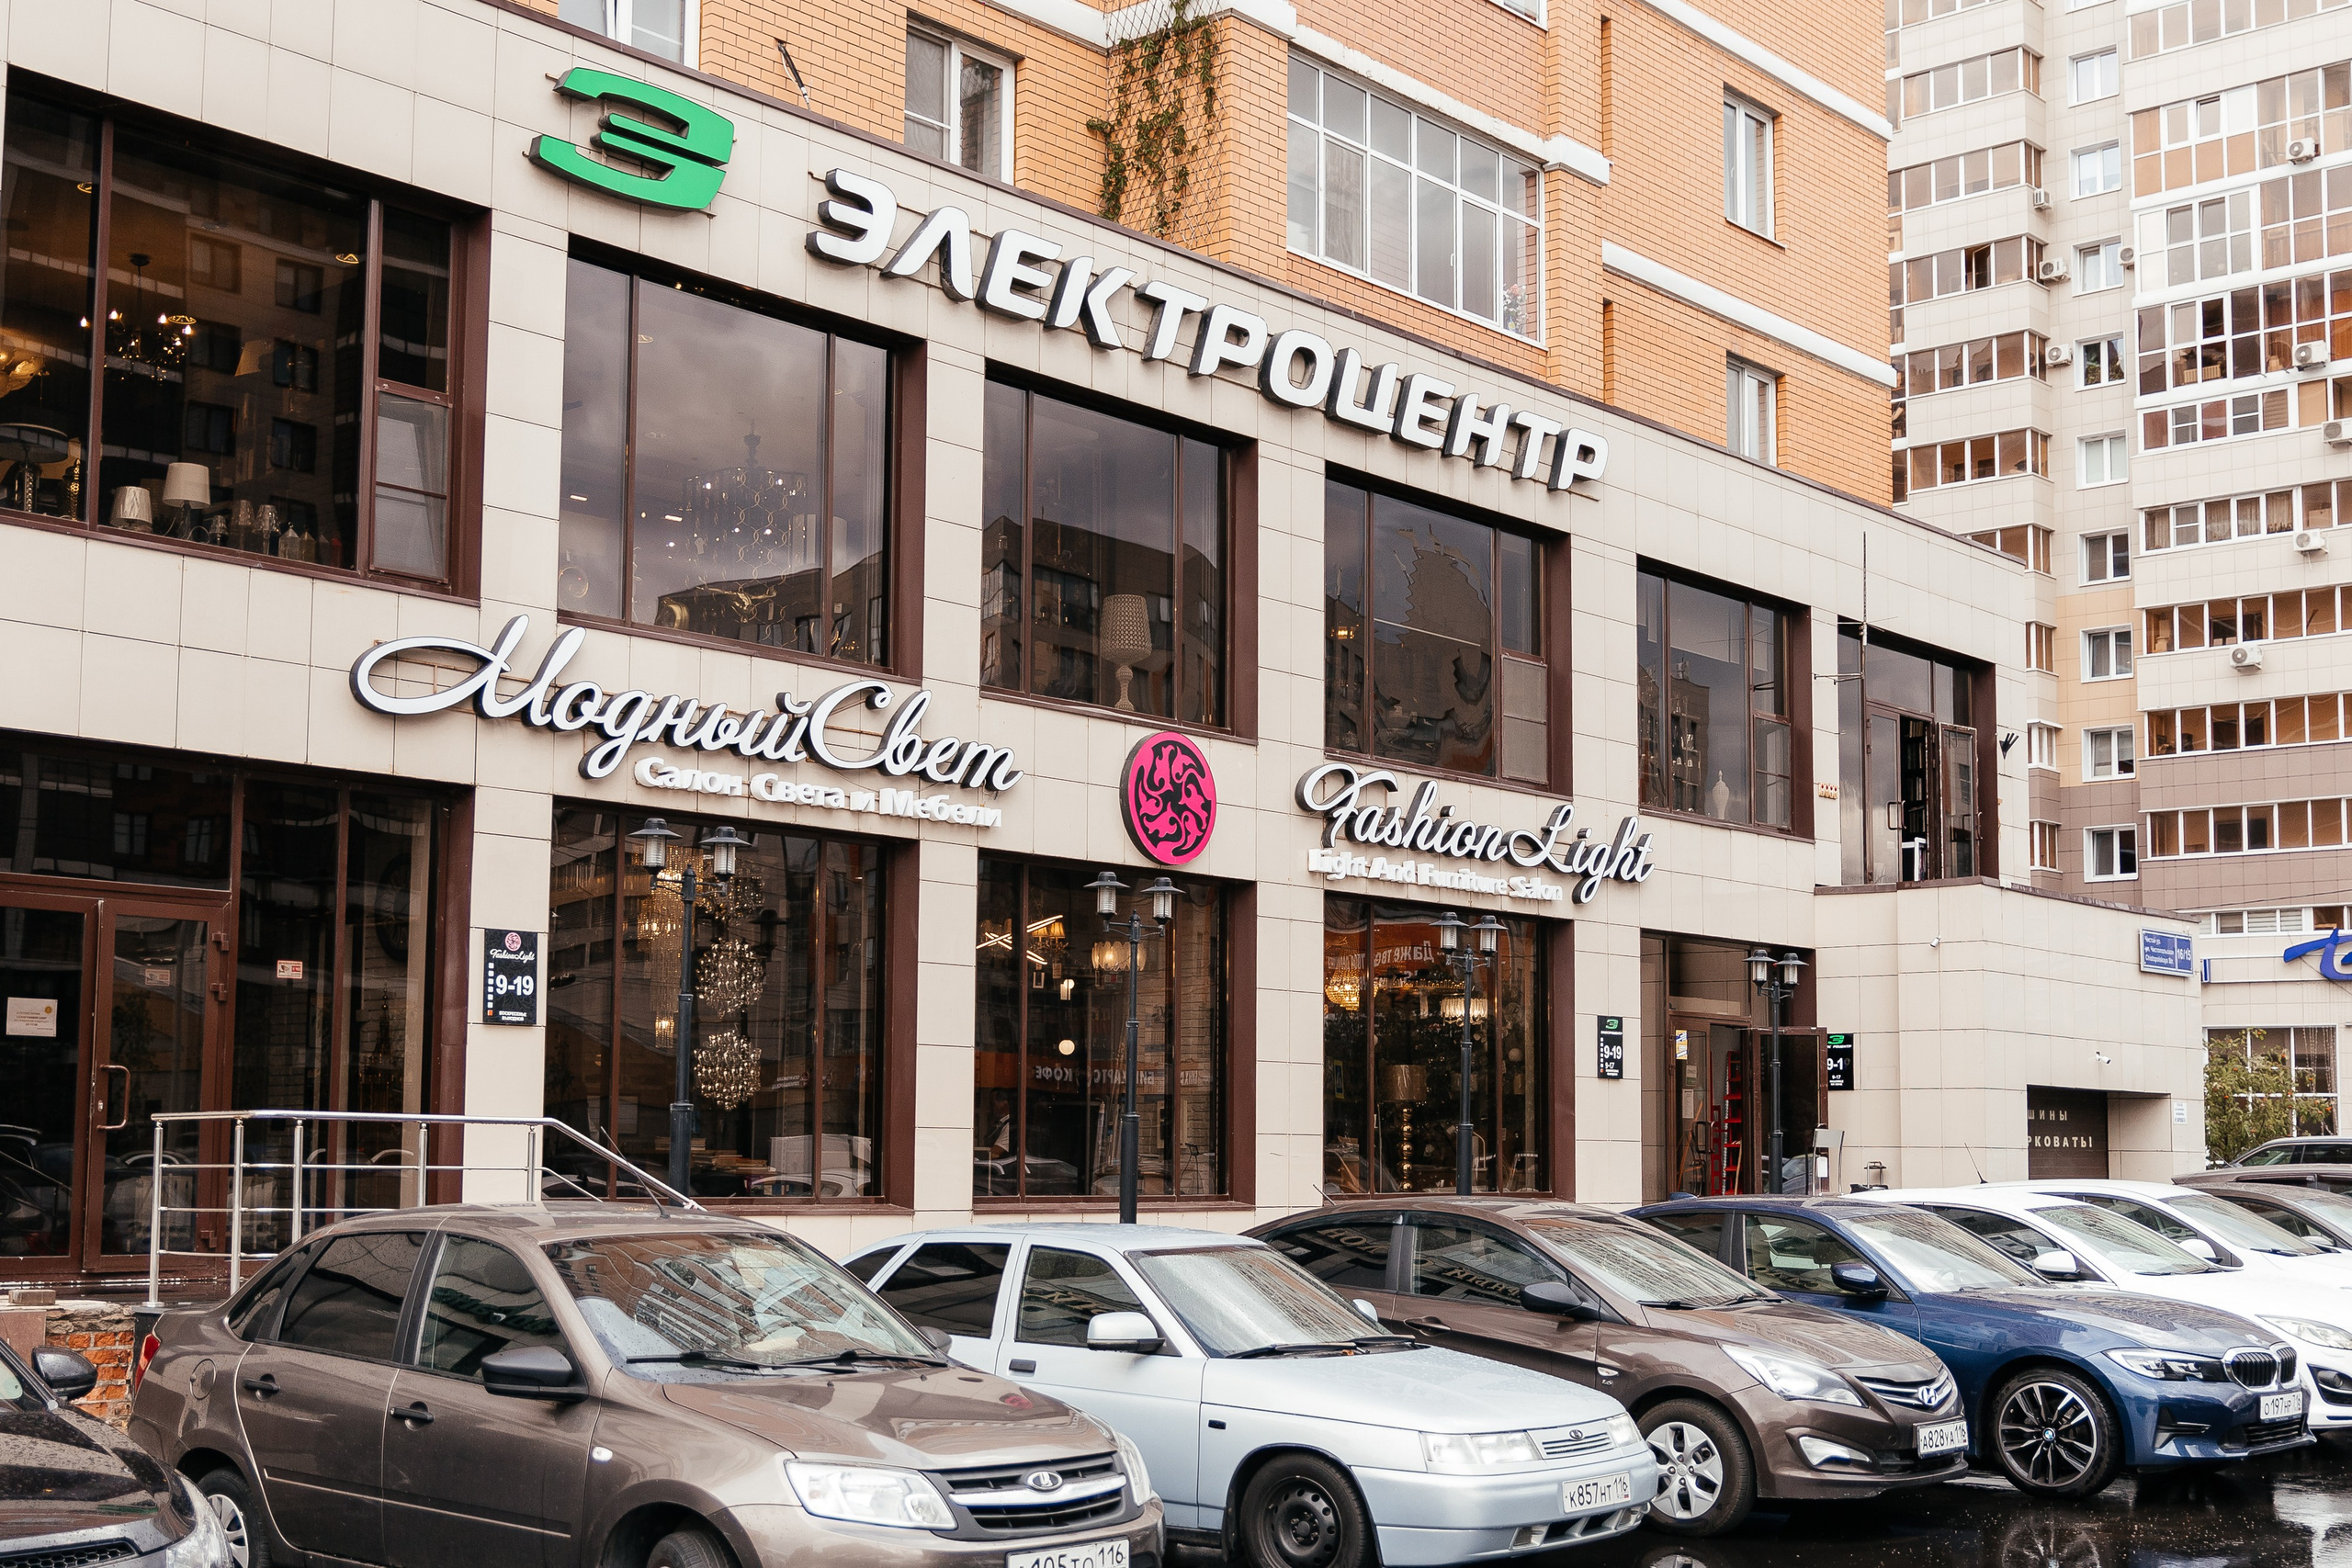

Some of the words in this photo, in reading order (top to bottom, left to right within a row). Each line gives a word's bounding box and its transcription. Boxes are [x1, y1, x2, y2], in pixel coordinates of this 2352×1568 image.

[804, 168, 1611, 491] ЭЛЕКТРОЦЕНТР
[634, 756, 742, 796] Салон
[749, 773, 844, 809] Света
[849, 791, 876, 813] и
[878, 787, 1002, 829] Мебели
[1308, 848, 1368, 880] Light
[1367, 856, 1416, 885] And
[1416, 863, 1508, 896] Furniture
[1508, 875, 1564, 902] Salon
[495, 975, 534, 996] 9-19
[1603, 1045, 1623, 1059] 9-19
[1569, 1482, 1611, 1508] К857НТ
[1613, 1475, 1628, 1494] 116
[1098, 1543, 1124, 1565] 116
